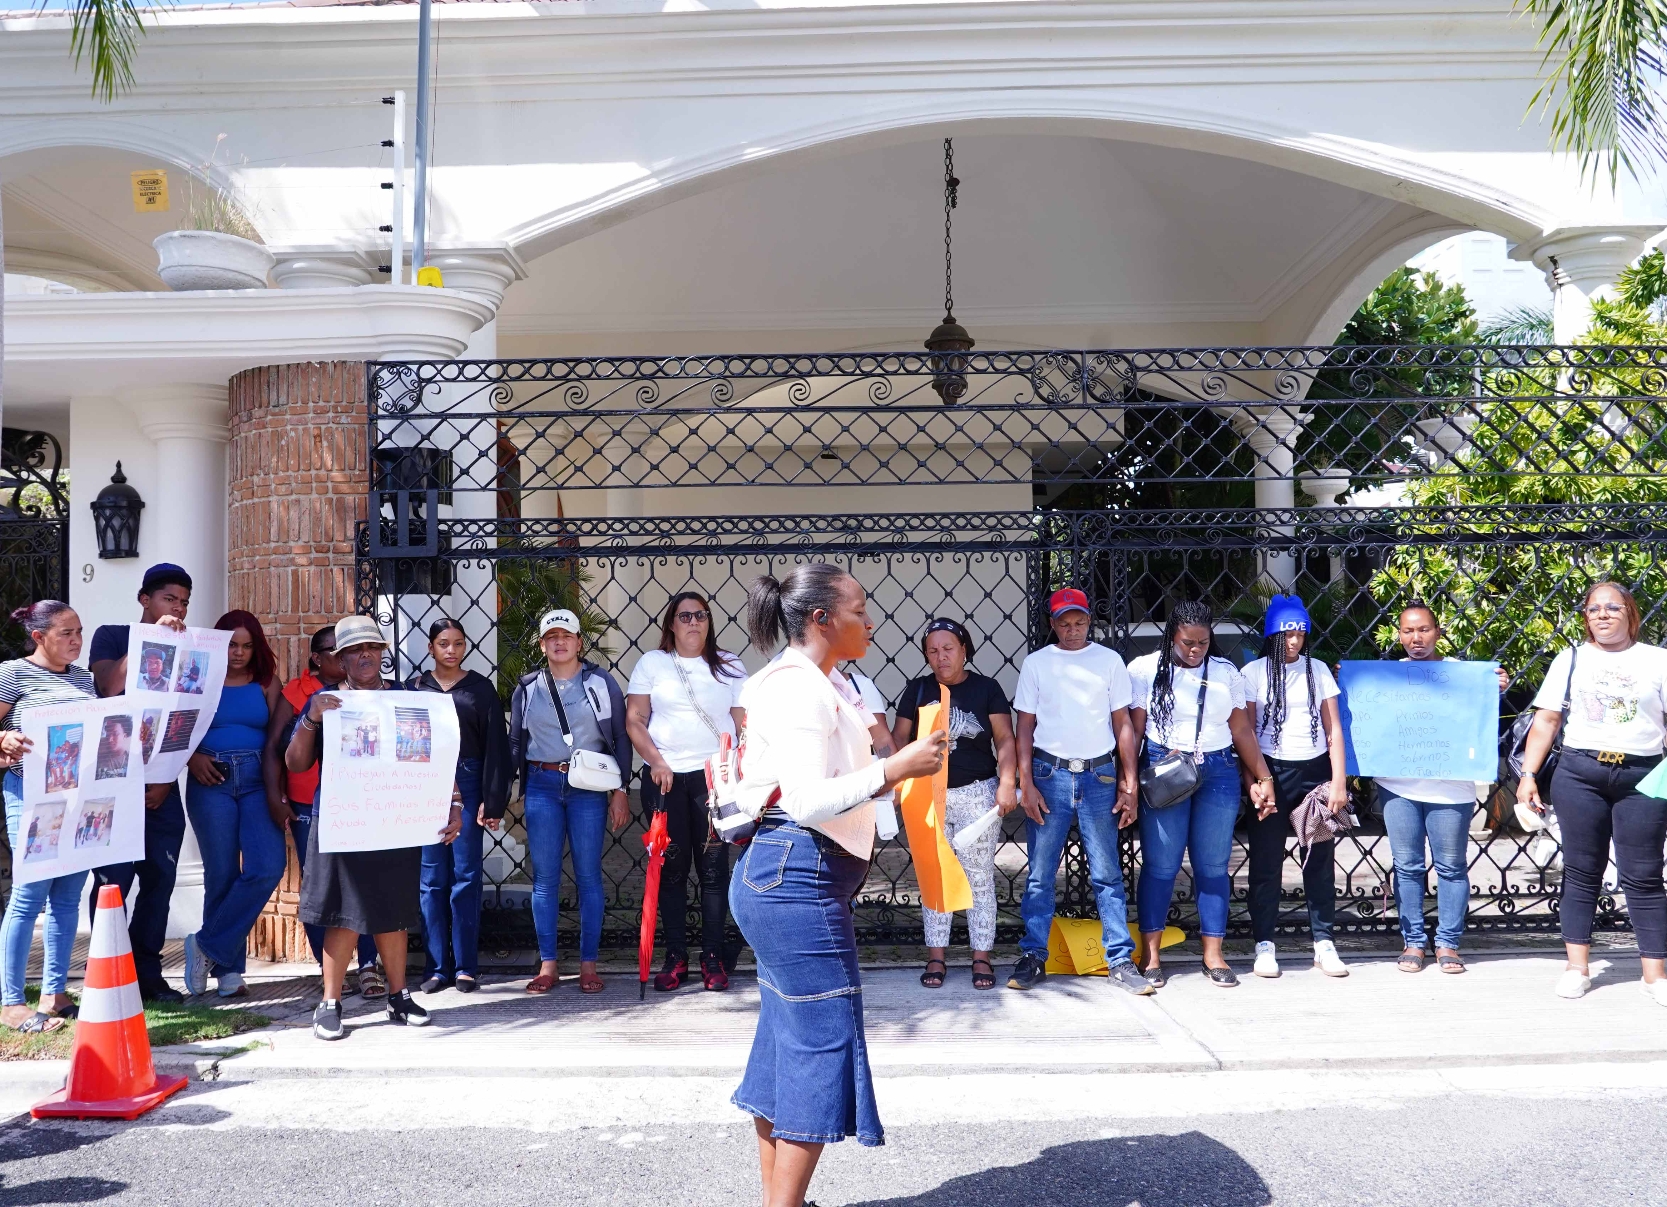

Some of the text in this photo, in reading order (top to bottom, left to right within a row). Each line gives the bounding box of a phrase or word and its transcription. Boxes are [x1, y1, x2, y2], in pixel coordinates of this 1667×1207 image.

[82, 563, 95, 583] 9
[1064, 591, 1075, 603] C
[1280, 621, 1306, 631] LOVE
[1407, 666, 1449, 685] Dios
[1342, 687, 1431, 703] Necesitamos
[1399, 724, 1438, 738] Amigos
[1398, 740, 1451, 751] Hermanos
[327, 797, 359, 815] Sus
